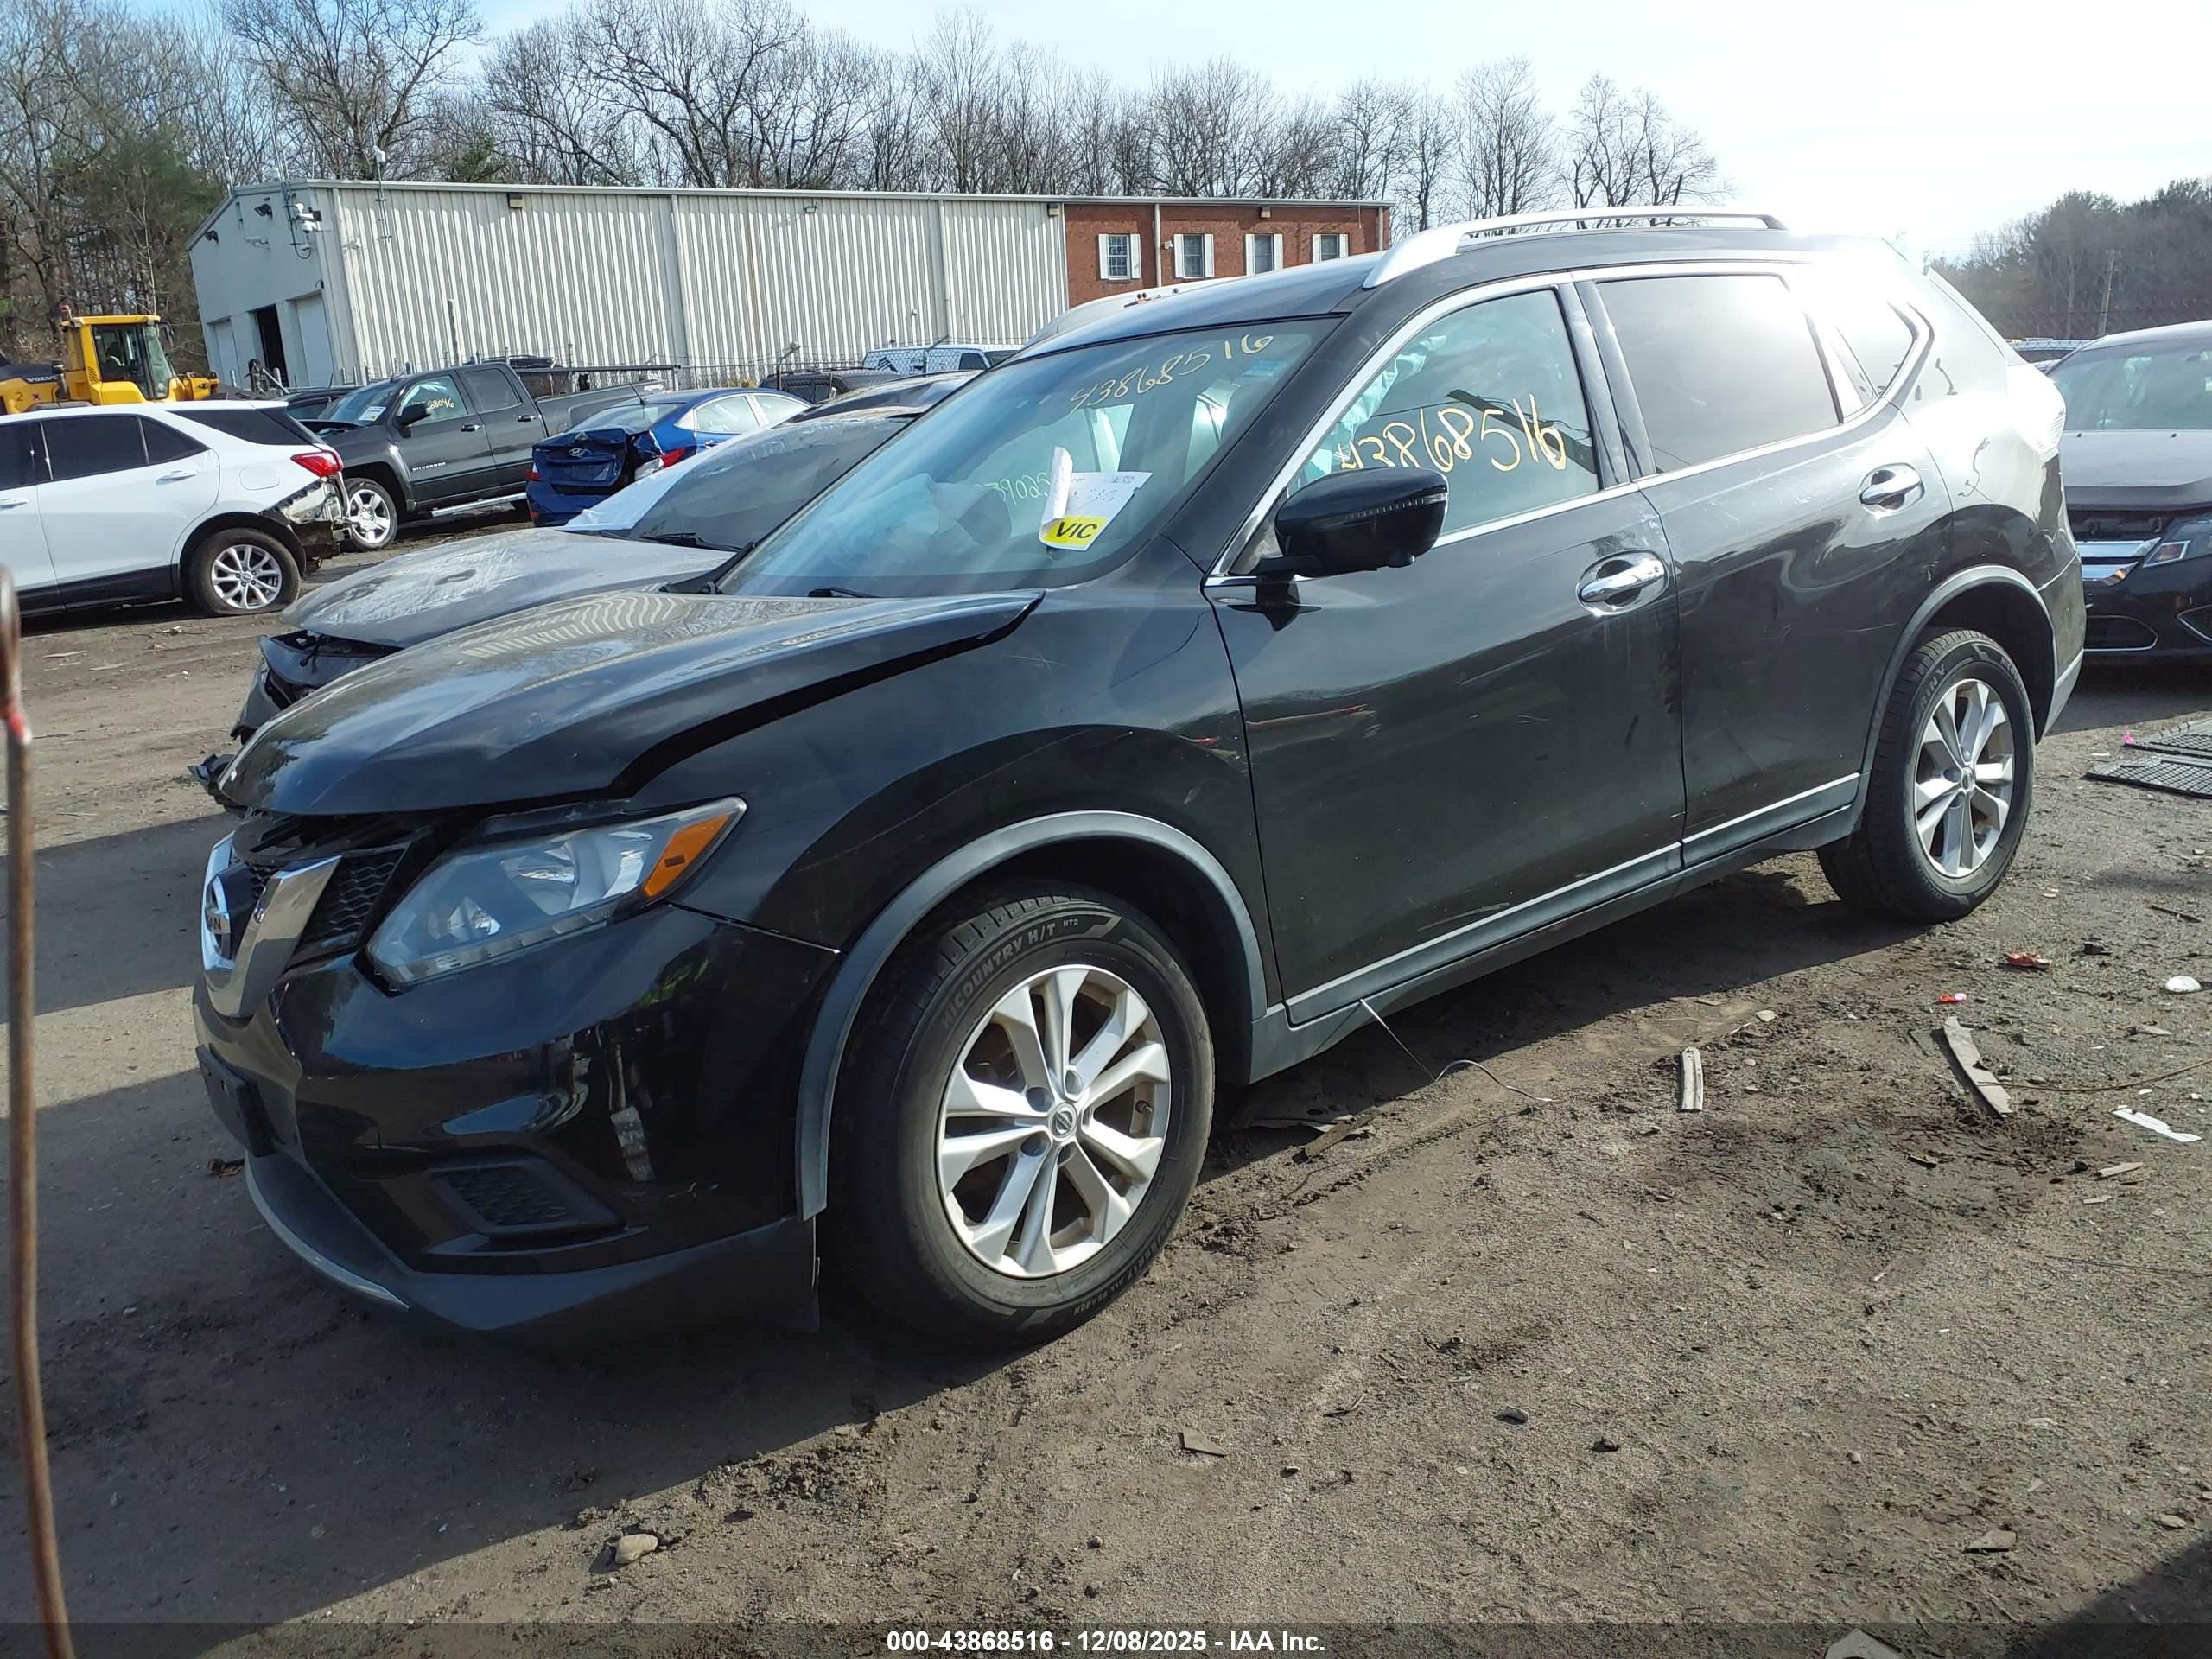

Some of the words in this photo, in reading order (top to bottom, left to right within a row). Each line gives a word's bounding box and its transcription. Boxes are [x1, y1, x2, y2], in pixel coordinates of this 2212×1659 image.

[1071, 334, 1274, 409] 43868516
[1336, 394, 1566, 472] 43868516
[1056, 521, 1097, 539] VIC
[1027, 922, 1056, 944] H/T
